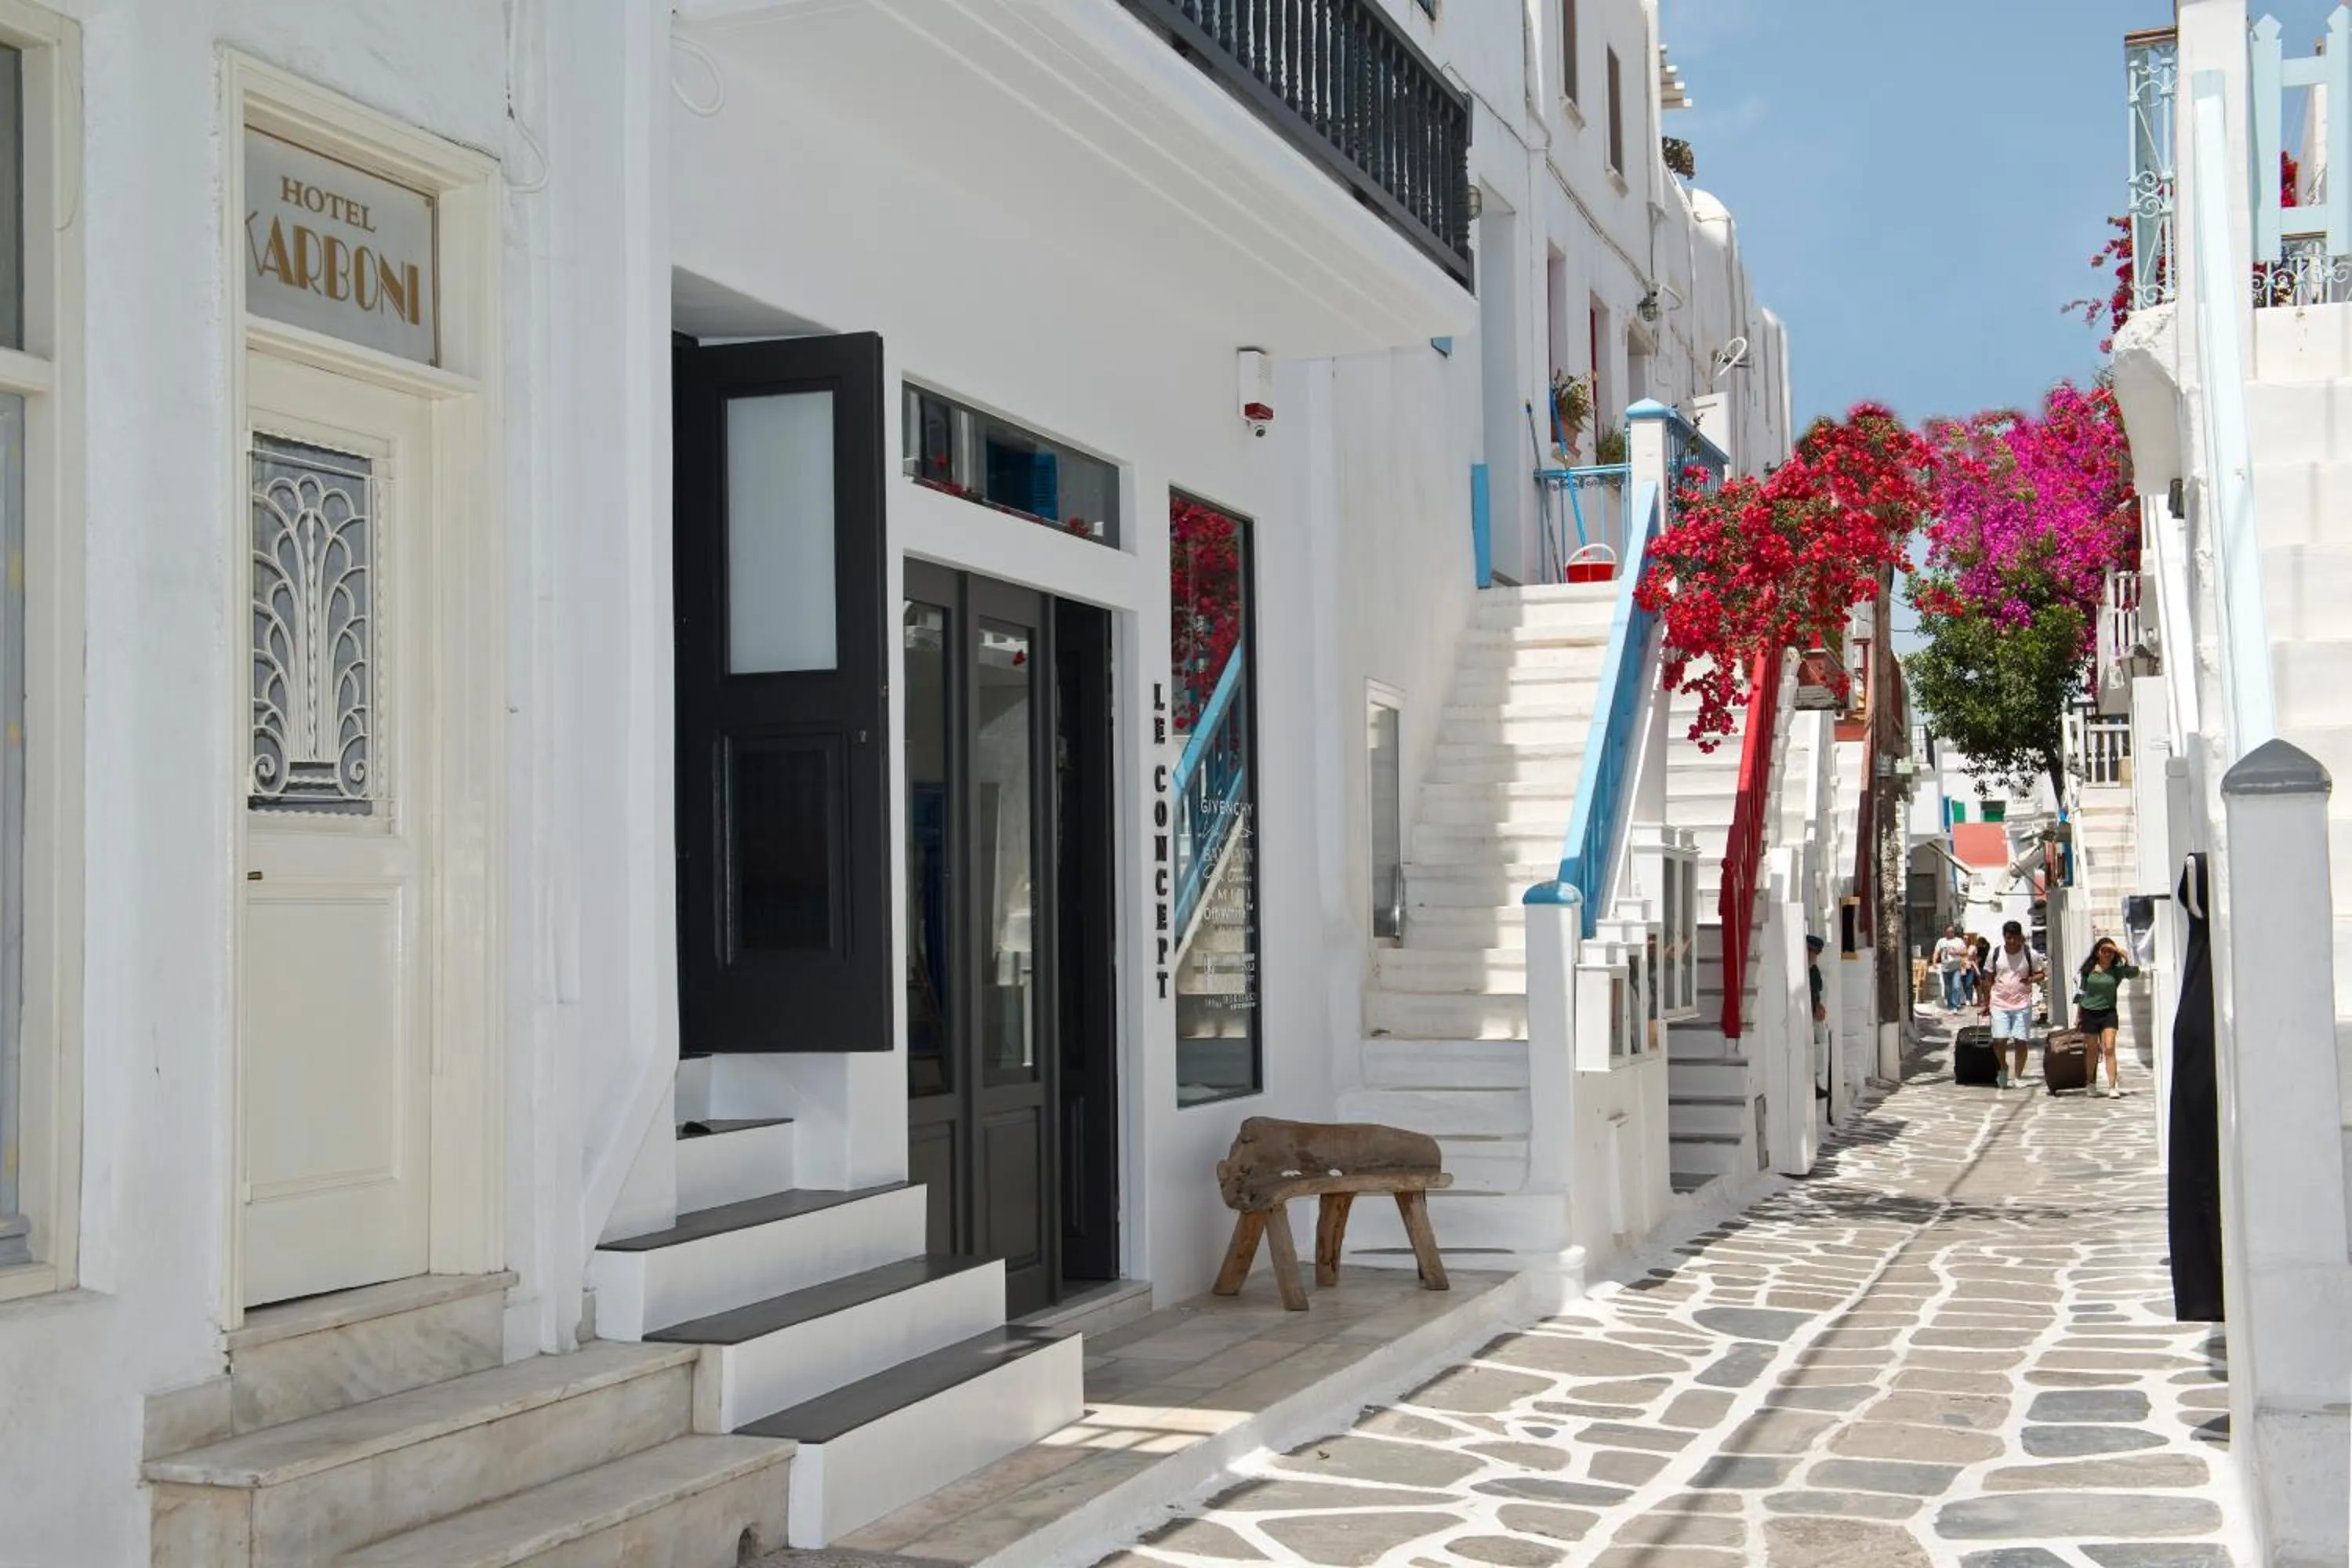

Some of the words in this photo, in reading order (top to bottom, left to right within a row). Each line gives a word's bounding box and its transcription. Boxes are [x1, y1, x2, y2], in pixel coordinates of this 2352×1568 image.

[280, 175, 376, 234] HOTEL
[1153, 683, 1166, 745] LE
[1154, 765, 1169, 1000] CONCEPT
